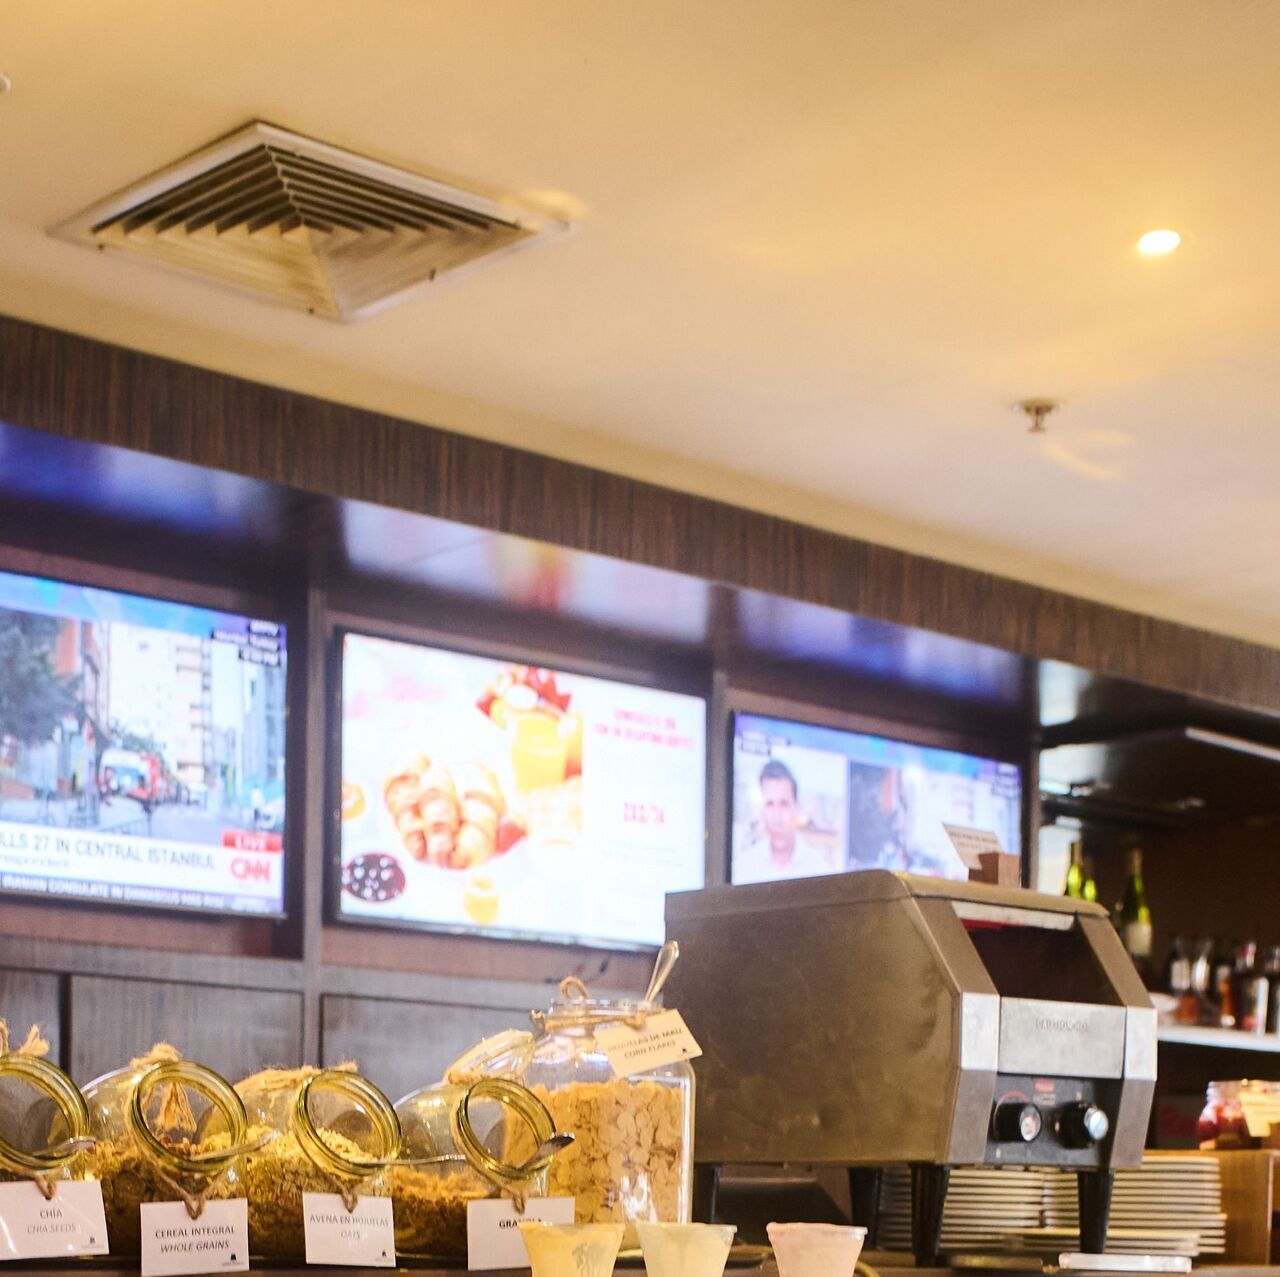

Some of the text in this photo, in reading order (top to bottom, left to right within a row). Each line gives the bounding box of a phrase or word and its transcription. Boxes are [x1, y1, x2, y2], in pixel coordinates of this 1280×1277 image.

[234, 835, 267, 853] LIVE
[34, 835, 50, 851] 27
[56, 838, 70, 854] IN
[75, 839, 142, 862] CENTRAL
[148, 847, 216, 870] ISTANBUL
[230, 858, 271, 883] CNN
[624, 1040, 677, 1058] CORN FLAKES
[40, 1207, 63, 1219] CHÍA
[310, 1214, 338, 1224] AVENA
[340, 1215, 351, 1224] EN
[51, 1223, 76, 1233] SEEDS
[155, 1226, 235, 1239] CEREAL INTEGRAL
[340, 1230, 361, 1239] OATS
[160, 1241, 230, 1253] WHOLE GRAINS
